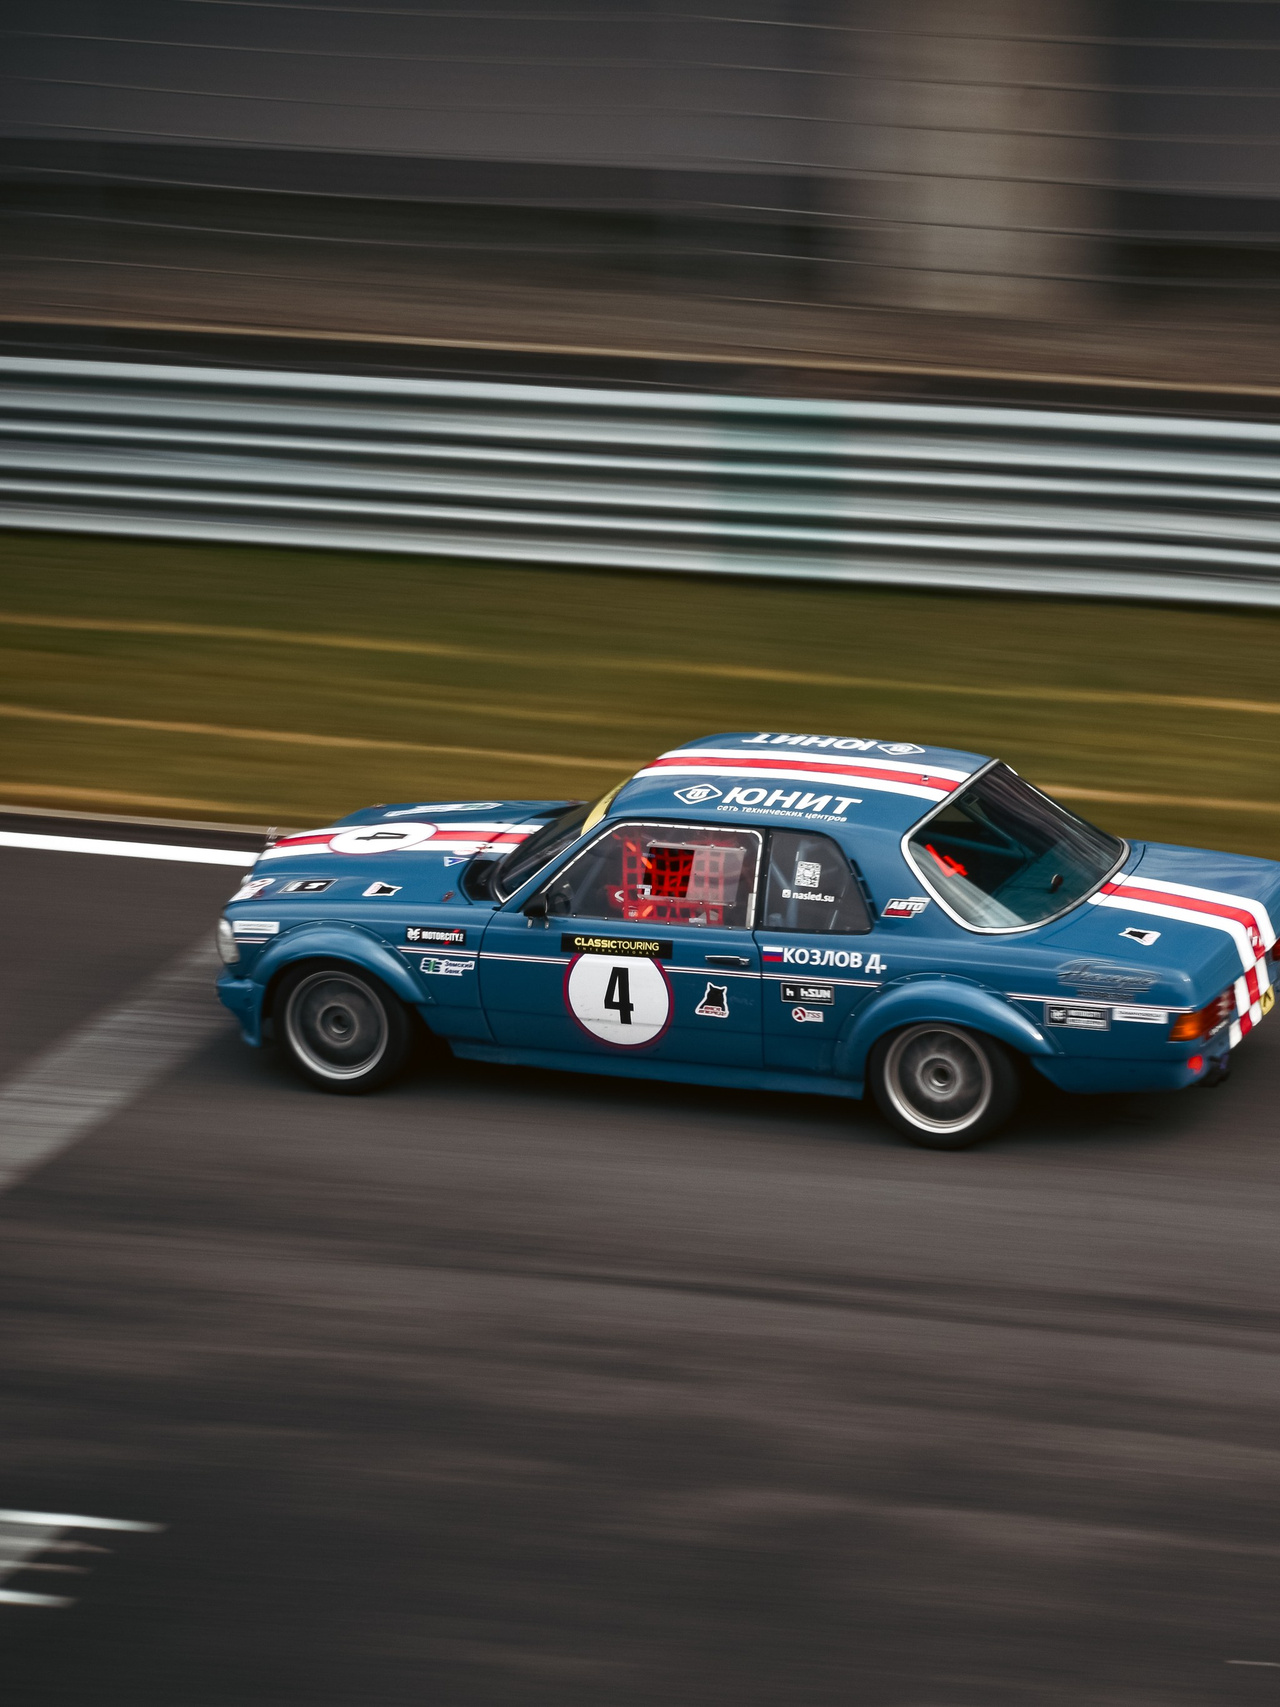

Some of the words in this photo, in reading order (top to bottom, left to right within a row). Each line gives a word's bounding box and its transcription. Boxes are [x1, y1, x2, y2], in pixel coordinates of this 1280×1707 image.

[721, 786, 863, 815] ЮНИТ
[741, 806, 803, 817] технических
[804, 813, 848, 822] центров
[792, 891, 835, 902] nasled.su
[577, 946, 656, 956] INTERNATIONAL
[783, 947, 863, 969] КОЗЛОВ
[864, 953, 887, 975] Д.
[604, 966, 634, 1025] 4
